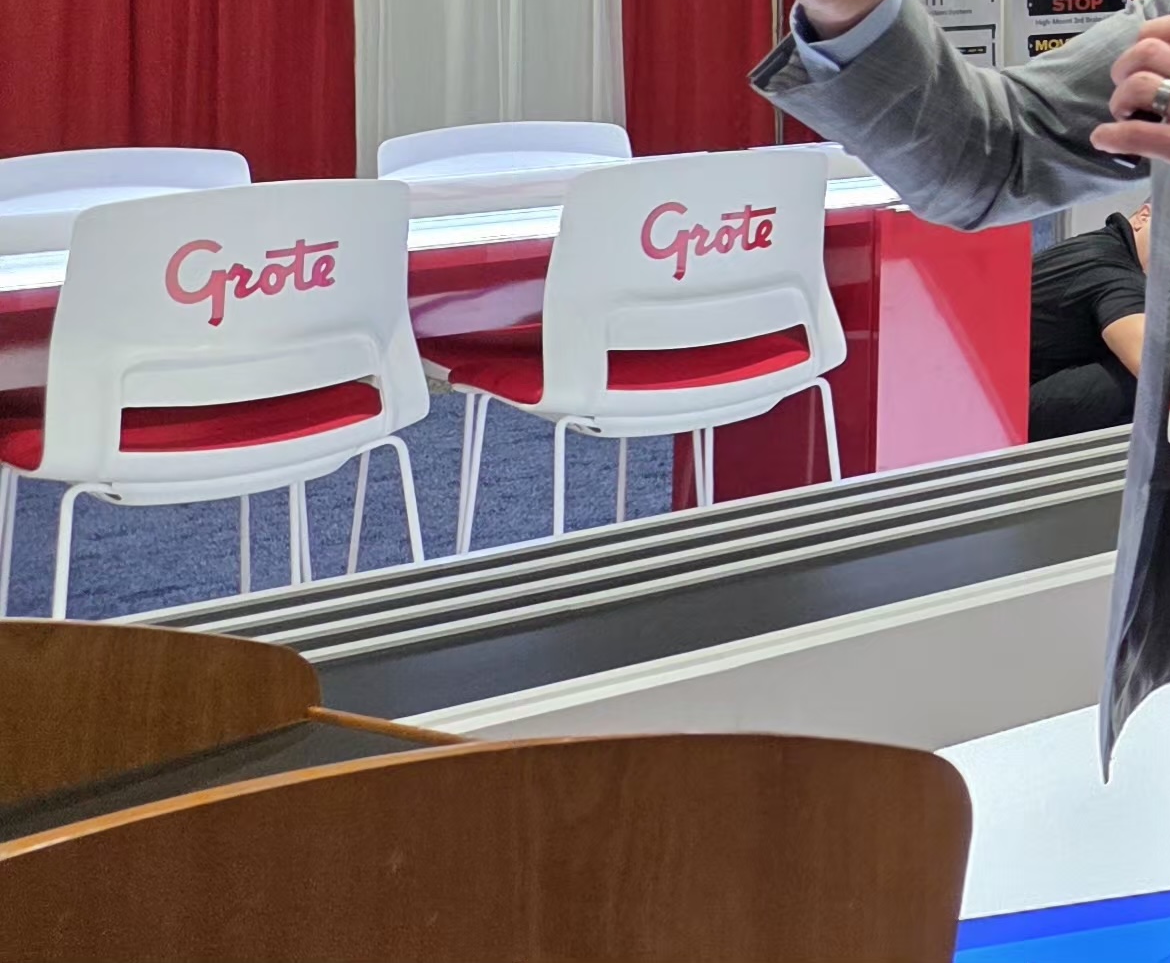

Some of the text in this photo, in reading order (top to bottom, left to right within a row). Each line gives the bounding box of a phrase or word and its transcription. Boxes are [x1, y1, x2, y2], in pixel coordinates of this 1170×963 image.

[1035, 38, 1069, 52] MOV
[641, 202, 777, 281] Grote
[165, 239, 340, 327] Grote
